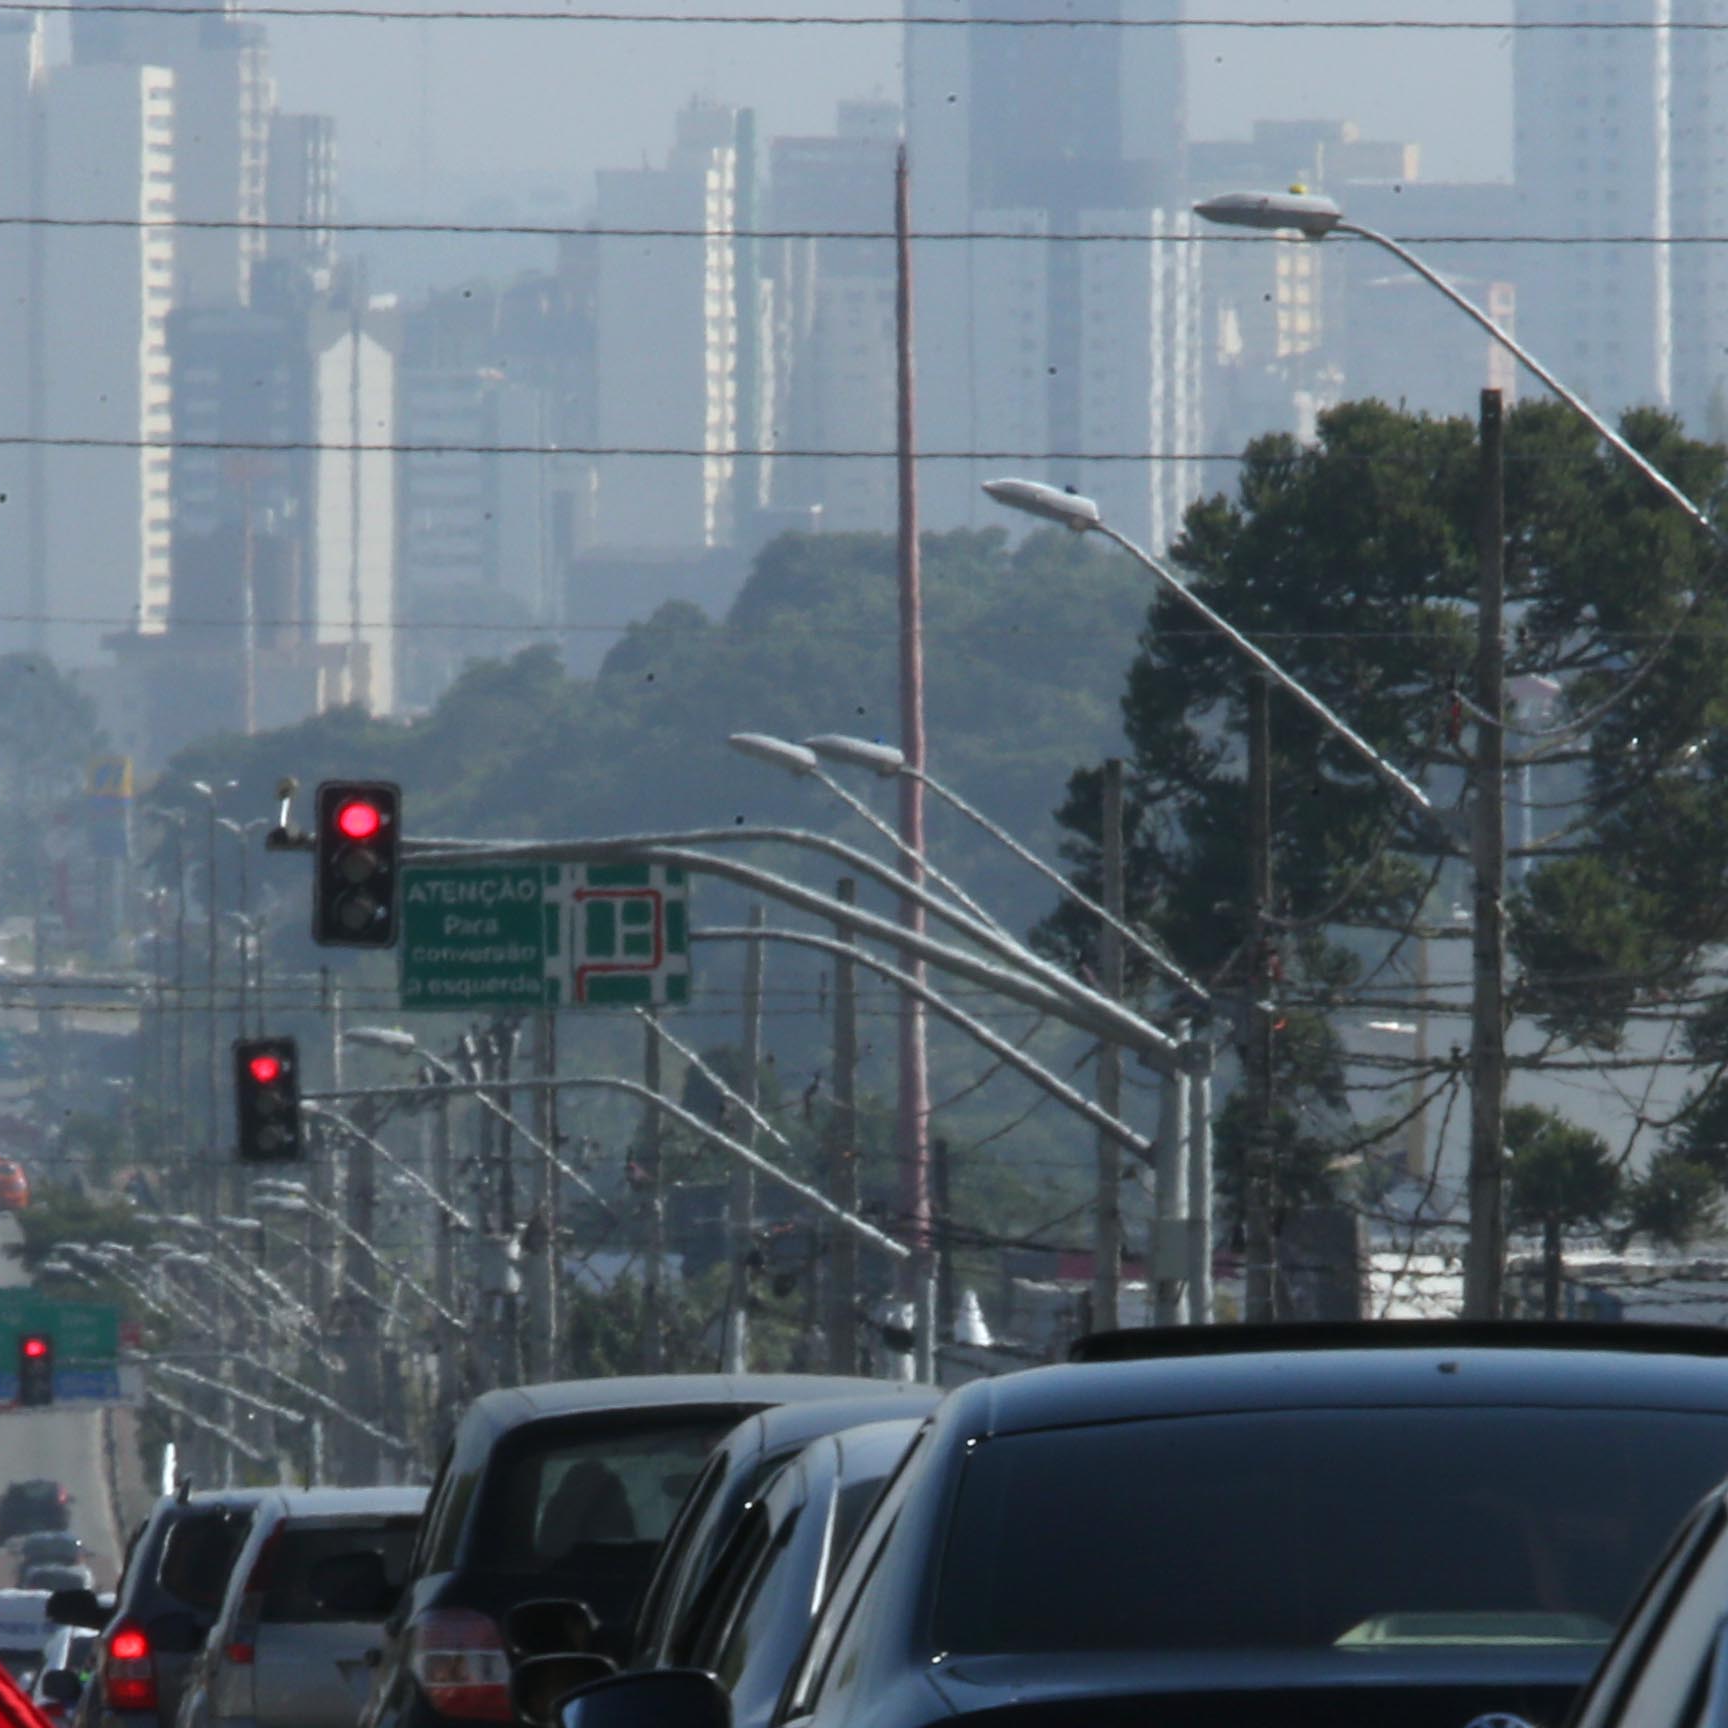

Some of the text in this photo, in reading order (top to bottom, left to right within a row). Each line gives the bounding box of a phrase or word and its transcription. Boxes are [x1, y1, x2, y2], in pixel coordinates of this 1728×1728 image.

[408, 877, 536, 907] ATENÇÃO
[443, 913, 500, 936] Para
[412, 941, 538, 964] conversão
[428, 975, 541, 998] esquerda
